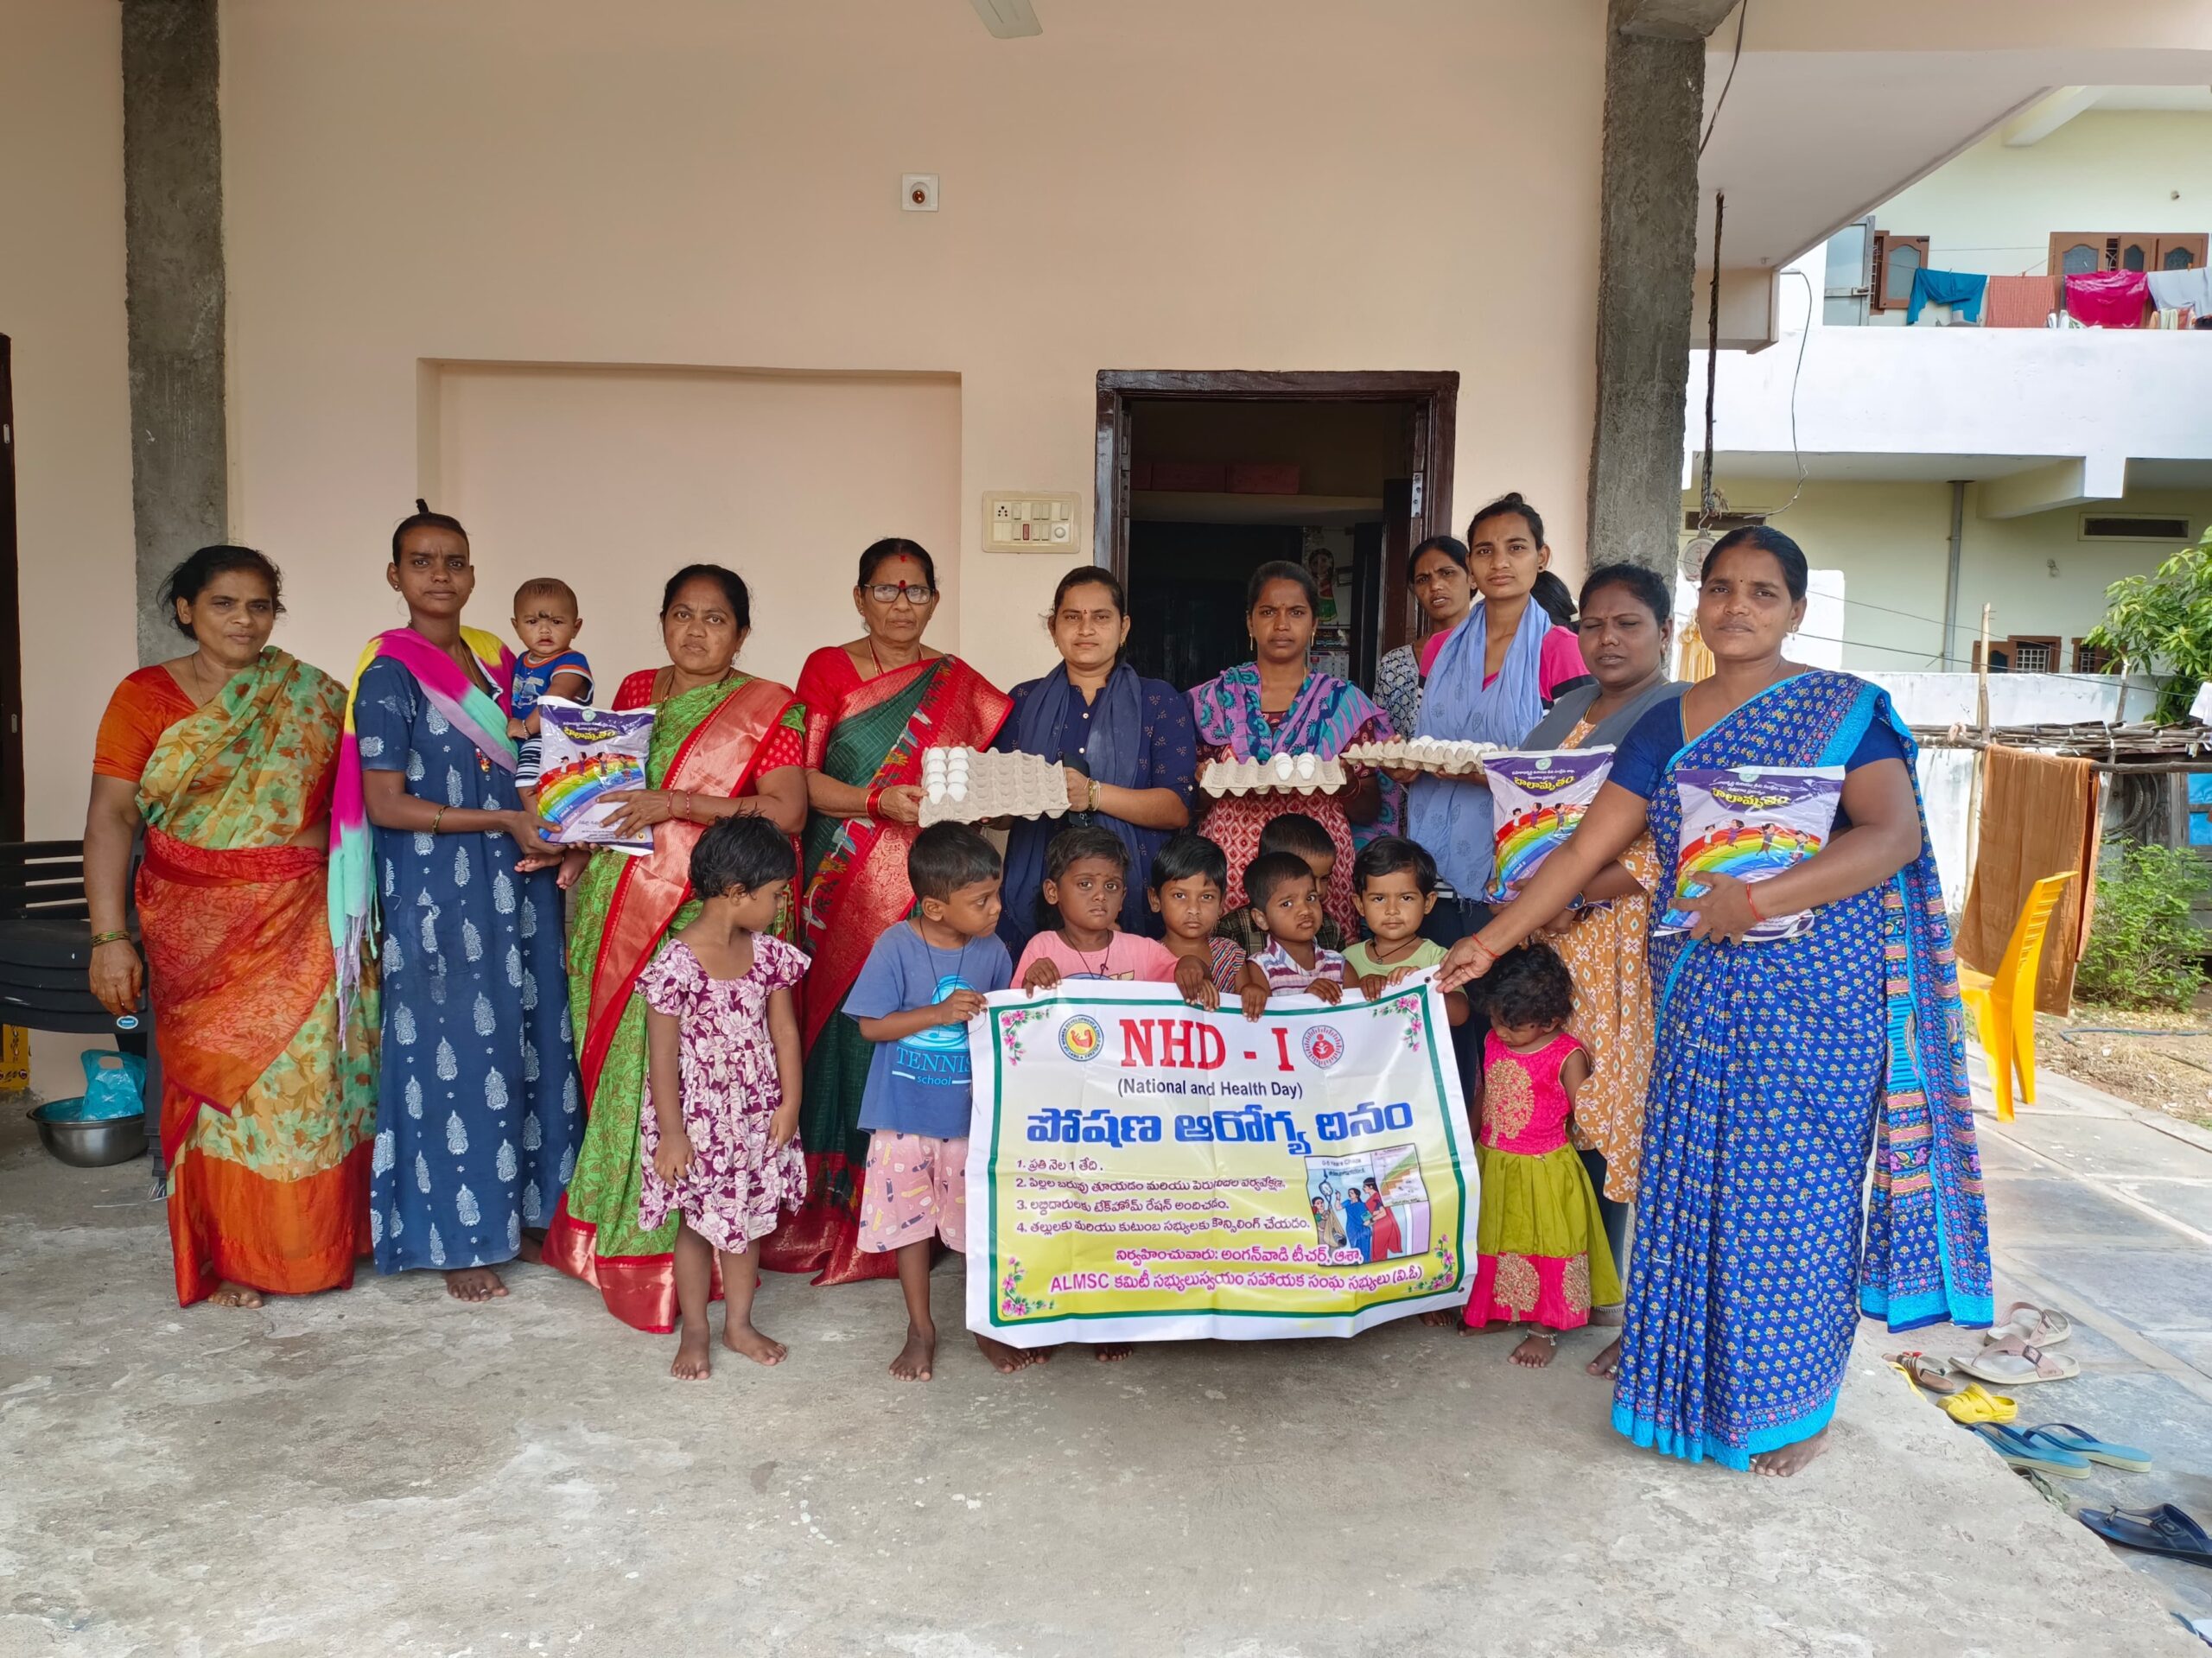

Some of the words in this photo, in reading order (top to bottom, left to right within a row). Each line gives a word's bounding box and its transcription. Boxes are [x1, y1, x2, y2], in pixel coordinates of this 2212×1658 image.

[1514, 776, 1574, 791] బాలామృతం
[1119, 1019, 1226, 1070] NHD
[1243, 1050, 1256, 1059] -
[1271, 1026, 1295, 1071] I
[917, 1075, 952, 1086] school
[1117, 1078, 1187, 1098] (National
[1191, 1083, 1216, 1096] and
[1220, 1082, 1268, 1097] Health
[1271, 1082, 1303, 1100] Day)
[1027, 1108, 1161, 1148] పోషణ
[1174, 1104, 1313, 1155] ఆరోగ్య
[1316, 1101, 1414, 1142] దినం
[1016, 1159, 1027, 1168] 1.
[1027, 1159, 1047, 1172] ప్రతి
[1049, 1159, 1066, 1171] నెల
[1070, 1161, 1075, 1171] 1
[1016, 1178, 1027, 1188] 2.
[1029, 1178, 1056, 1190] పిల్లల
[1058, 1181, 1089, 1193] బరువు
[1147, 1180, 1190, 1191] మరియు
[1016, 1200, 1027, 1210] 3.
[1146, 1198, 1173, 1212] రేషన్
[1016, 1223, 1027, 1232] 4.
[1030, 1221, 1072, 1236] తల్లులకు
[1074, 1220, 1116, 1232] మరియు
[1118, 1222, 1161, 1232] కుటుంబ
[1164, 1220, 1210, 1235] సభ్యులకు
[1263, 1216, 1310, 1229] చేయడం.
[1051, 1273, 1109, 1293] ALMSC
[1114, 1269, 1150, 1288] కమిటీ
[1247, 1272, 1305, 1287] సహాయక
[1308, 1274, 1344, 1289] సంఘ
[1348, 1274, 1390, 1291] సభ్యులు
